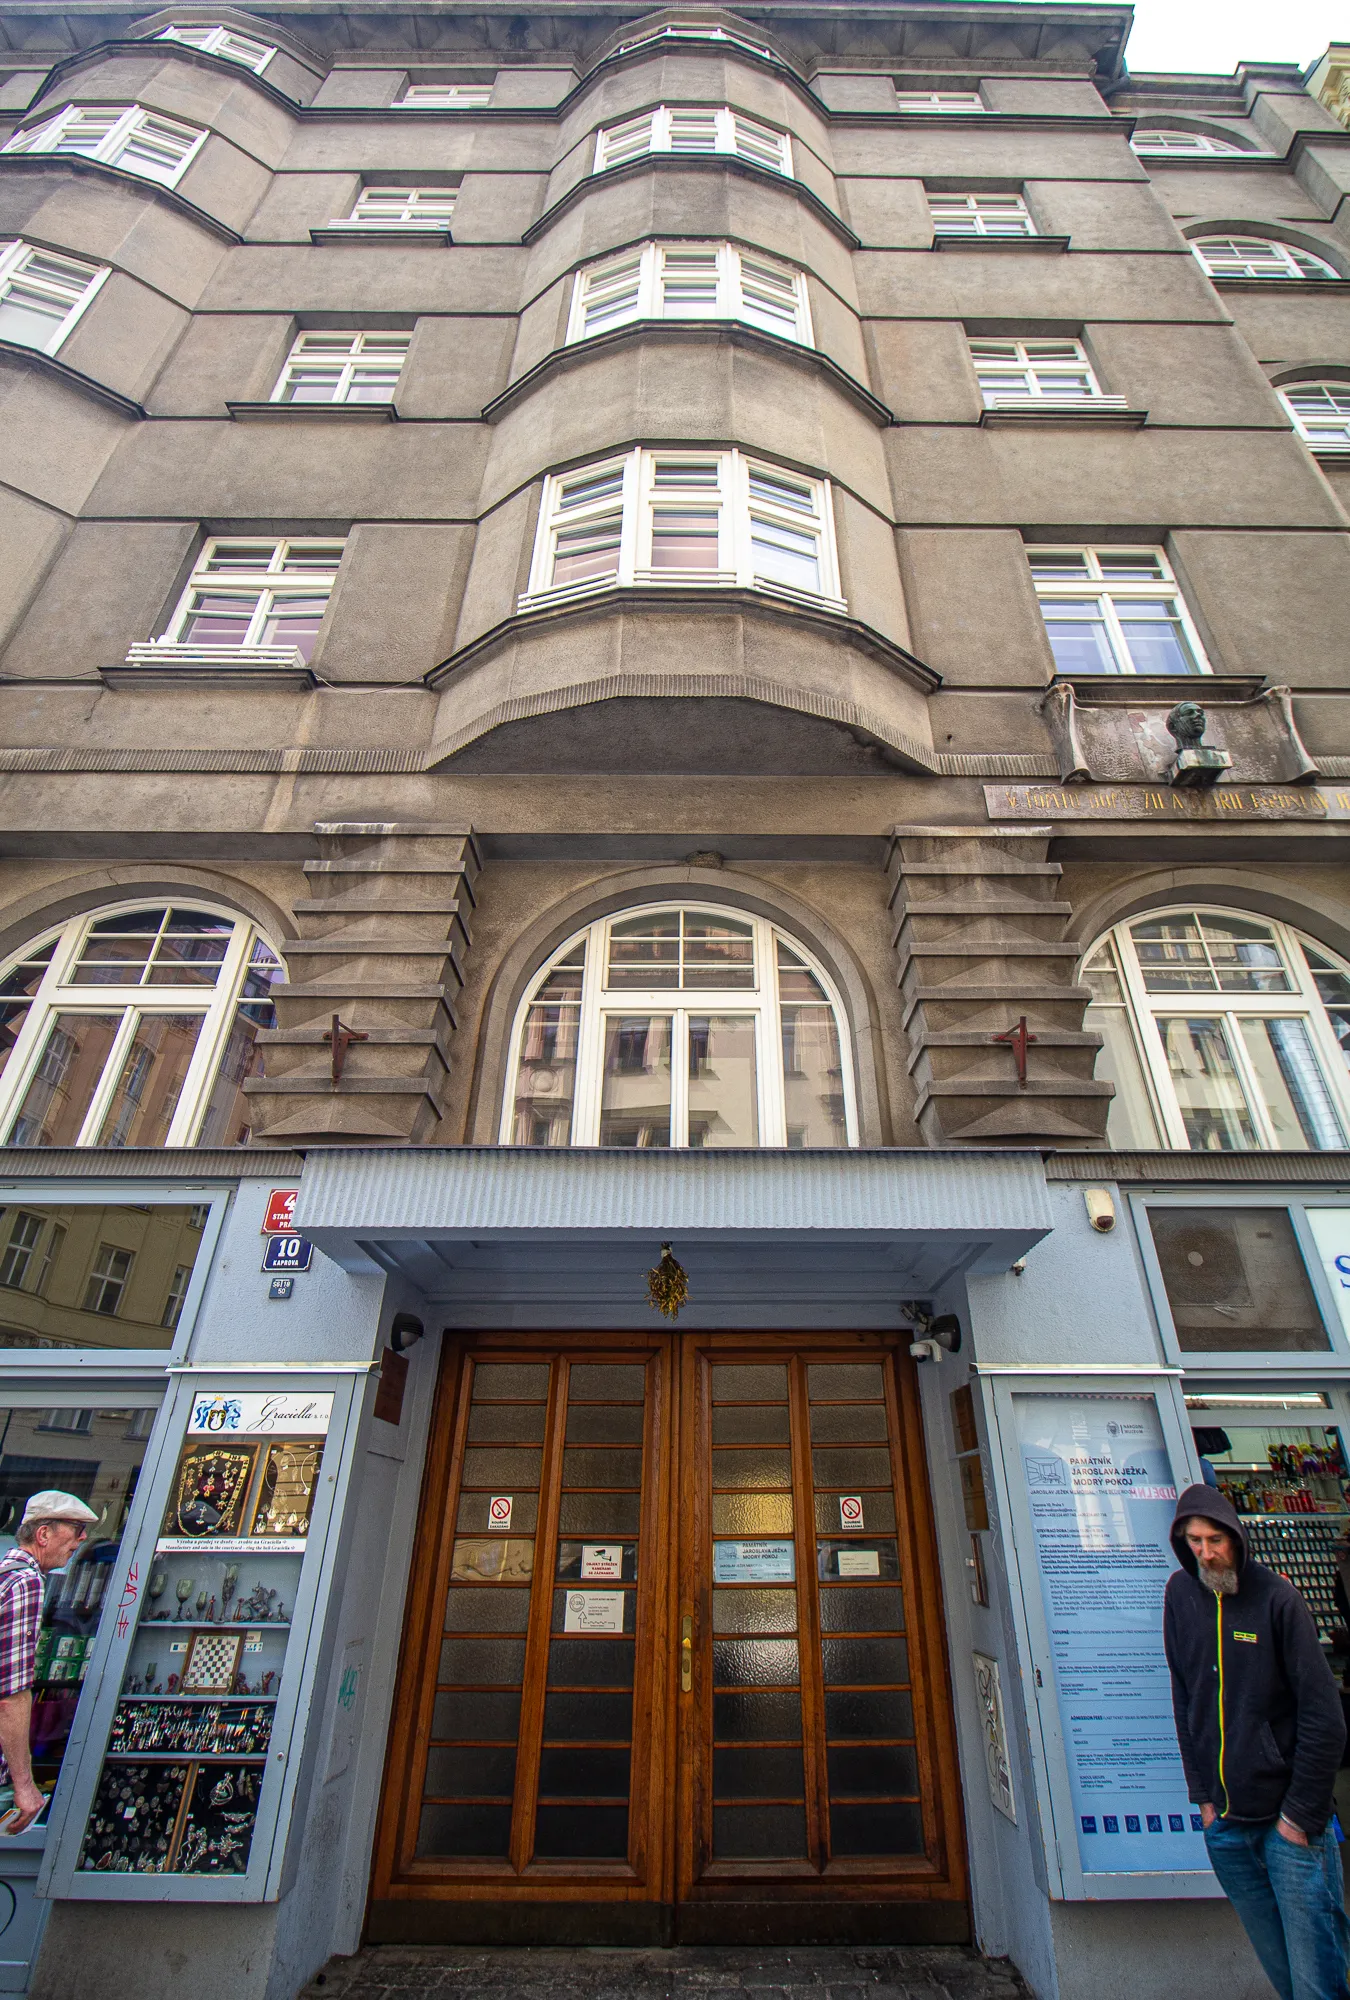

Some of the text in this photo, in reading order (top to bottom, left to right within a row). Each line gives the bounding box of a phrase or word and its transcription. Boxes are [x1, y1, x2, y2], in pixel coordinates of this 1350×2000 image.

[1006, 791, 1016, 808] V
[1172, 792, 1184, 809] A
[277, 1238, 301, 1257] 10
[246, 1395, 317, 1431] Graciella
[1070, 1456, 1112, 1465] PAMÁTNÍK
[1072, 1466, 1148, 1476] JAROSLAVA JEŽKA
[1073, 1477, 1103, 1485] MODRÝ
